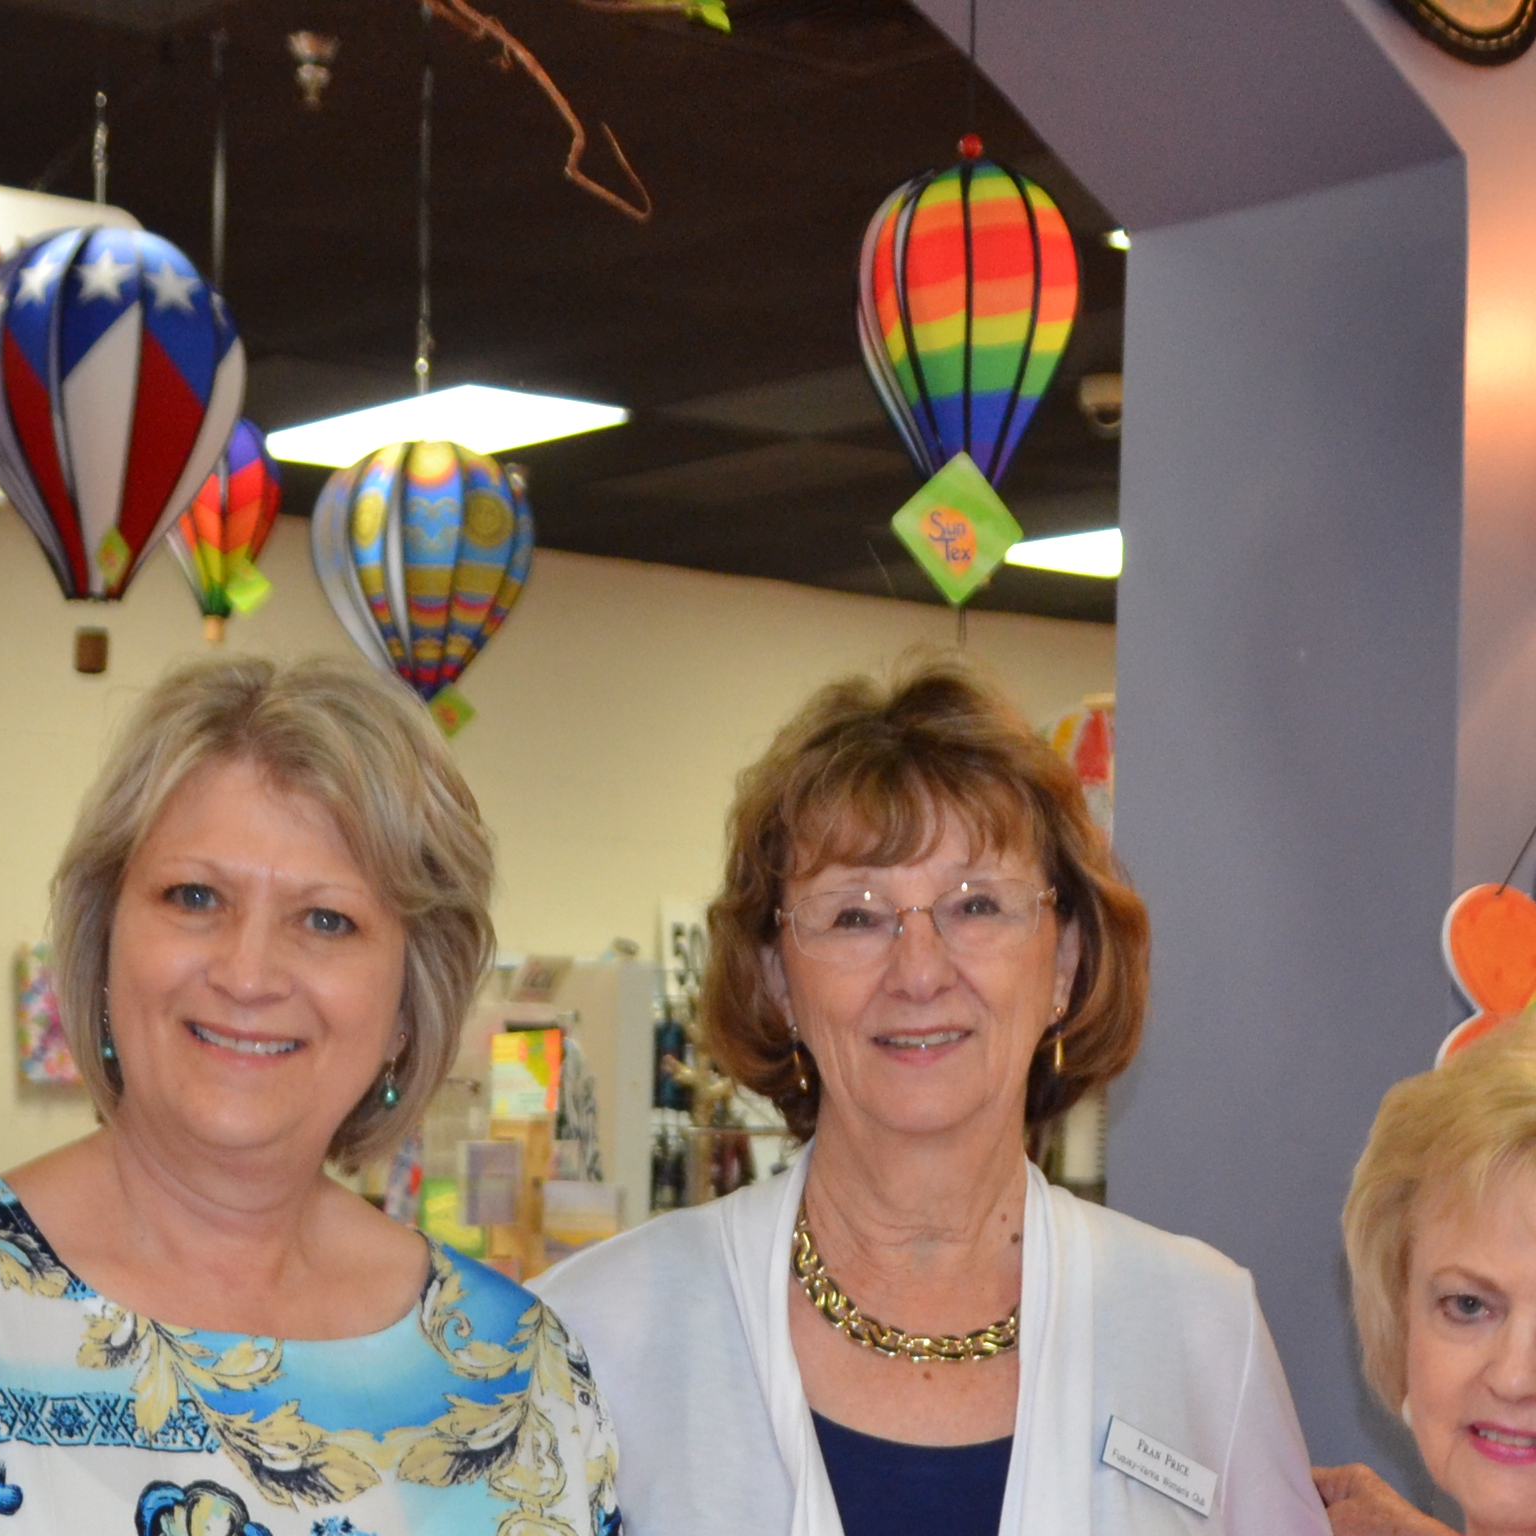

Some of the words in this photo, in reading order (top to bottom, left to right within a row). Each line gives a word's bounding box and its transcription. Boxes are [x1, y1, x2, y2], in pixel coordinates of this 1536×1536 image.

[928, 511, 967, 541] Sun
[935, 538, 970, 562] Tex
[1136, 1438, 1162, 1461] FRAN
[1164, 1452, 1190, 1477] PRICE
